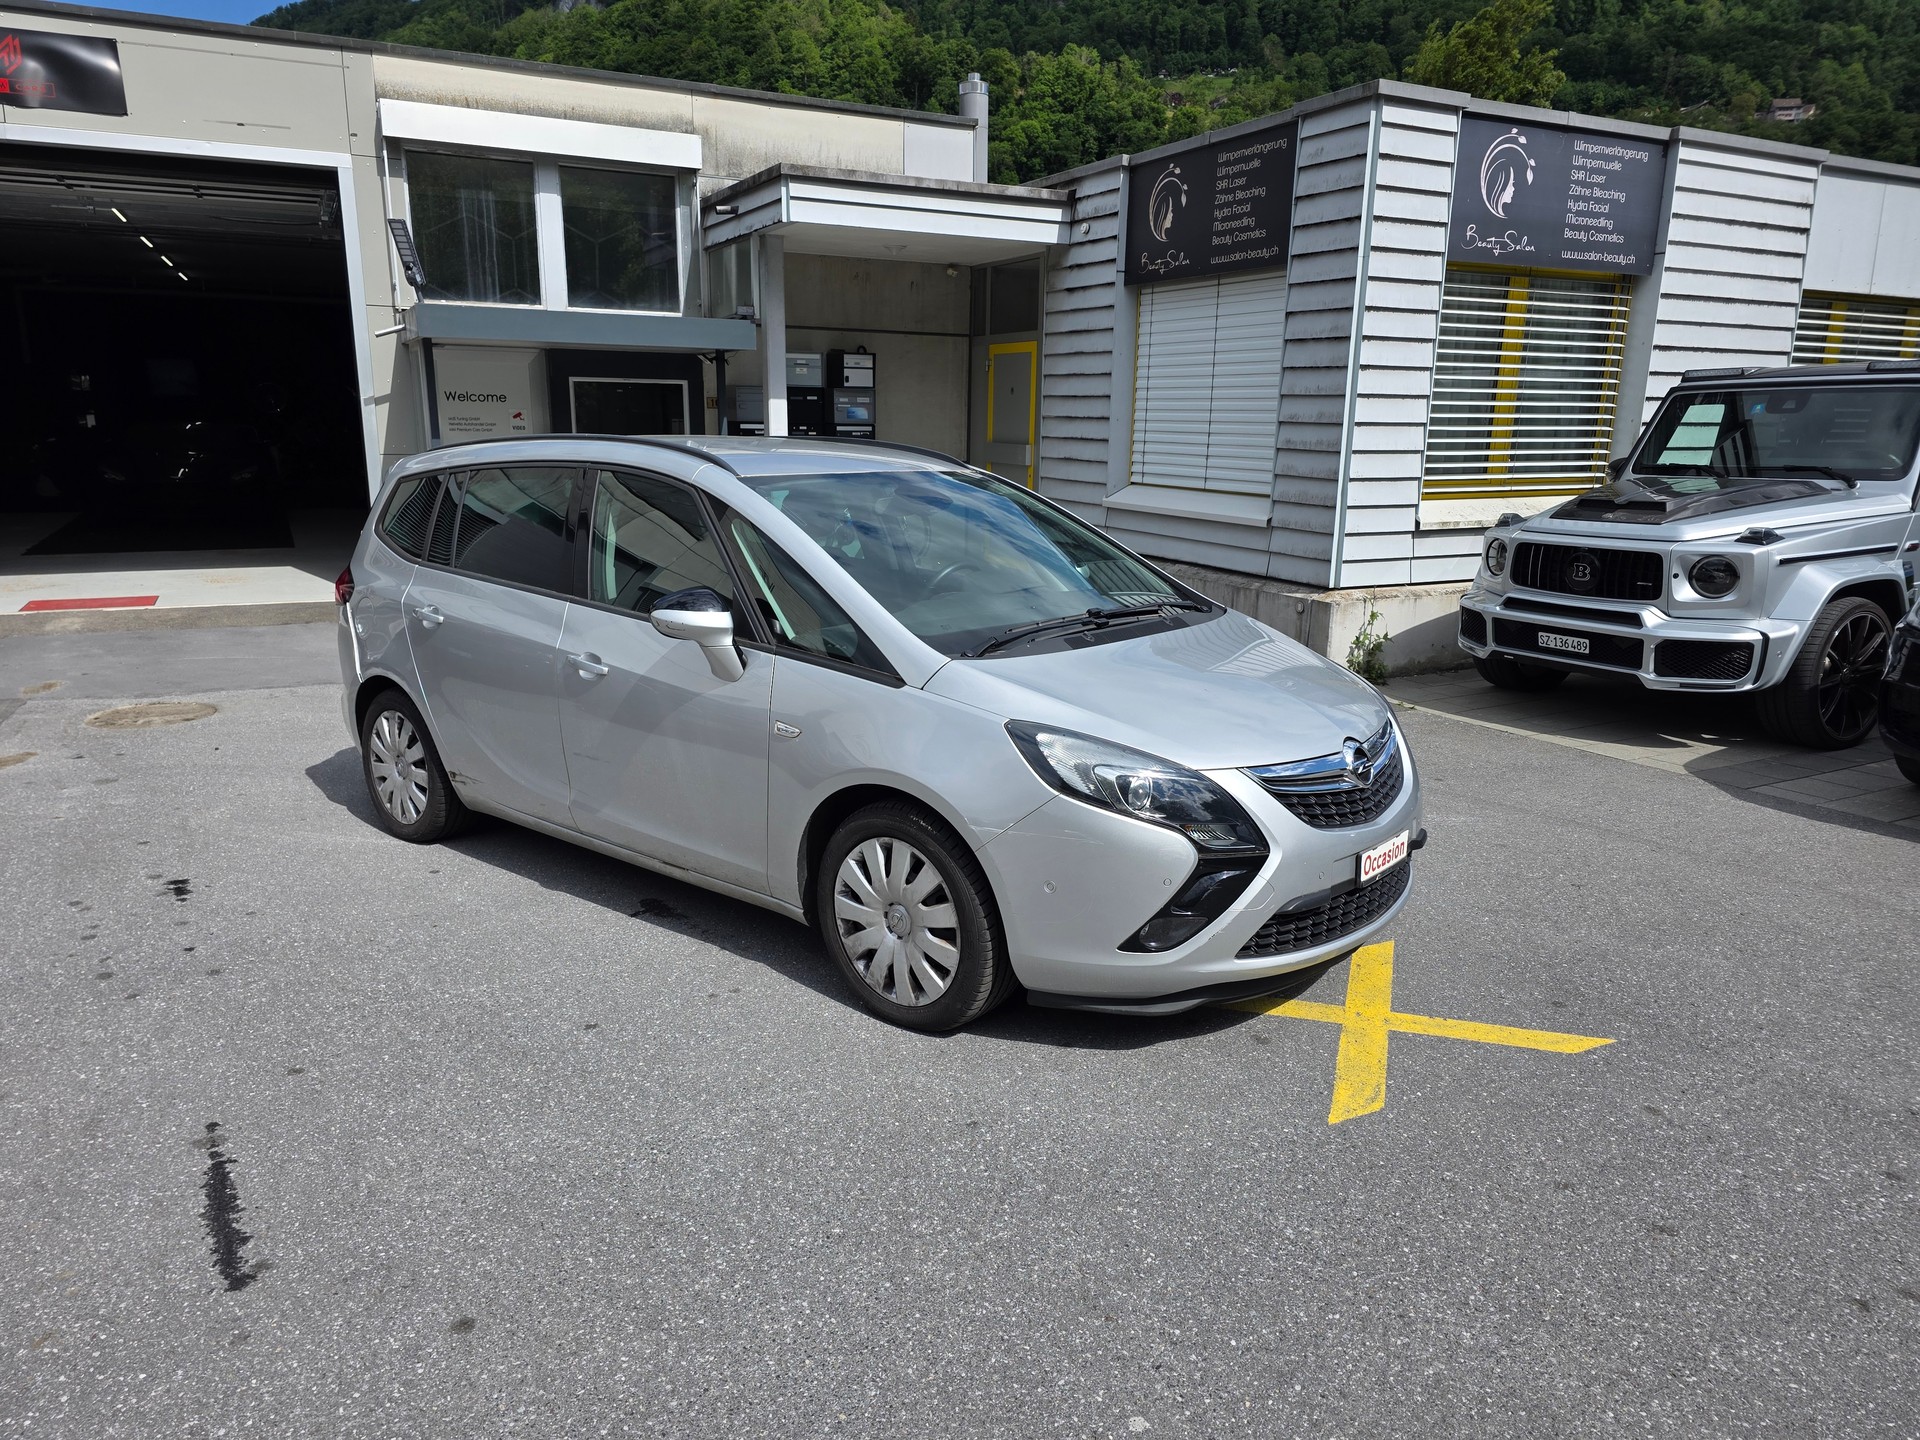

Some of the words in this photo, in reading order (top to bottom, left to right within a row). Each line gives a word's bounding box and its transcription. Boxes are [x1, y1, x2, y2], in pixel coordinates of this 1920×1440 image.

[1217, 138, 1287, 163] Wimpernverlängerung
[1574, 140, 1649, 162] Wimpernverlängerung
[1216, 158, 1261, 177] Wimpernwelle
[1572, 155, 1622, 171] Wimpernwelle
[1215, 180, 1228, 191] SHR
[1229, 176, 1247, 188] Laser
[1570, 170, 1585, 182] SHR
[1586, 171, 1606, 184] Laser
[1215, 191, 1235, 205] Zähne
[1235, 185, 1266, 200] Bleaching
[1569, 184, 1592, 197] Zähne
[1593, 186, 1626, 203] Bleaching
[1214, 206, 1232, 220] Hydra
[1232, 202, 1250, 215] Facial
[1567, 199, 1588, 214] Hydra
[1589, 201, 1610, 213] Facial
[1213, 216, 1255, 232] Microneedling
[1565, 214, 1614, 230] Microneedling
[1212, 231, 1233, 246] Beauty
[1233, 228, 1267, 242] Cosmetics
[1461, 224, 1502, 256] Beauty
[1503, 230, 1536, 252] Salon
[1564, 229, 1588, 242] Beauty
[1589, 230, 1625, 244] Cosmetics
[1139, 252, 1167, 275] Beauty
[1166, 249, 1191, 268] Salon
[1210, 245, 1279, 265] www.salon-beauty.ch
[1561, 250, 1636, 264] www.salon-beauty.ch
[444, 391, 507, 402] Welcome
[1572, 562, 1591, 581] B
[1363, 841, 1405, 876] Occasion
